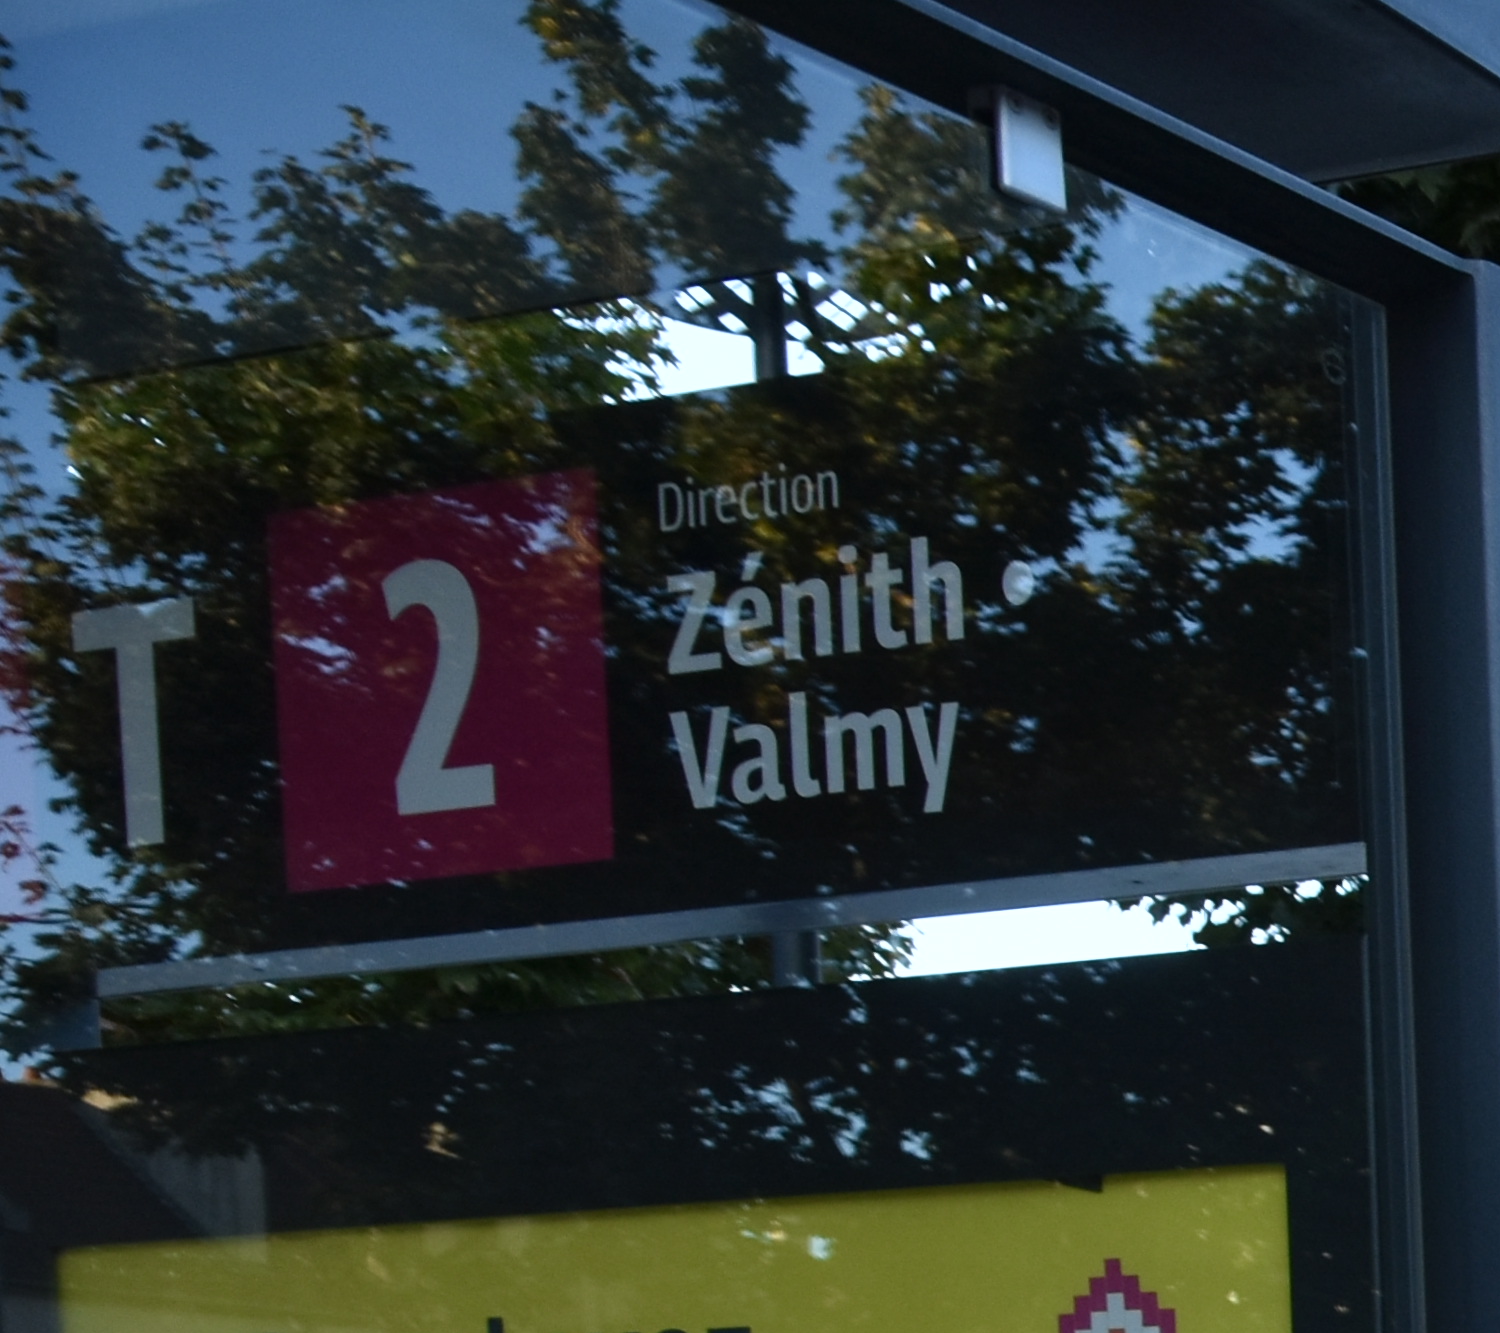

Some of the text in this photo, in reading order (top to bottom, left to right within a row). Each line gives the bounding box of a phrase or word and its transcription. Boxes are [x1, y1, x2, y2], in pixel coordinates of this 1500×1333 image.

[656, 463, 841, 533] Direction
[72, 535, 965, 847] T 2 Zénith
[669, 692, 959, 813] Valmy
